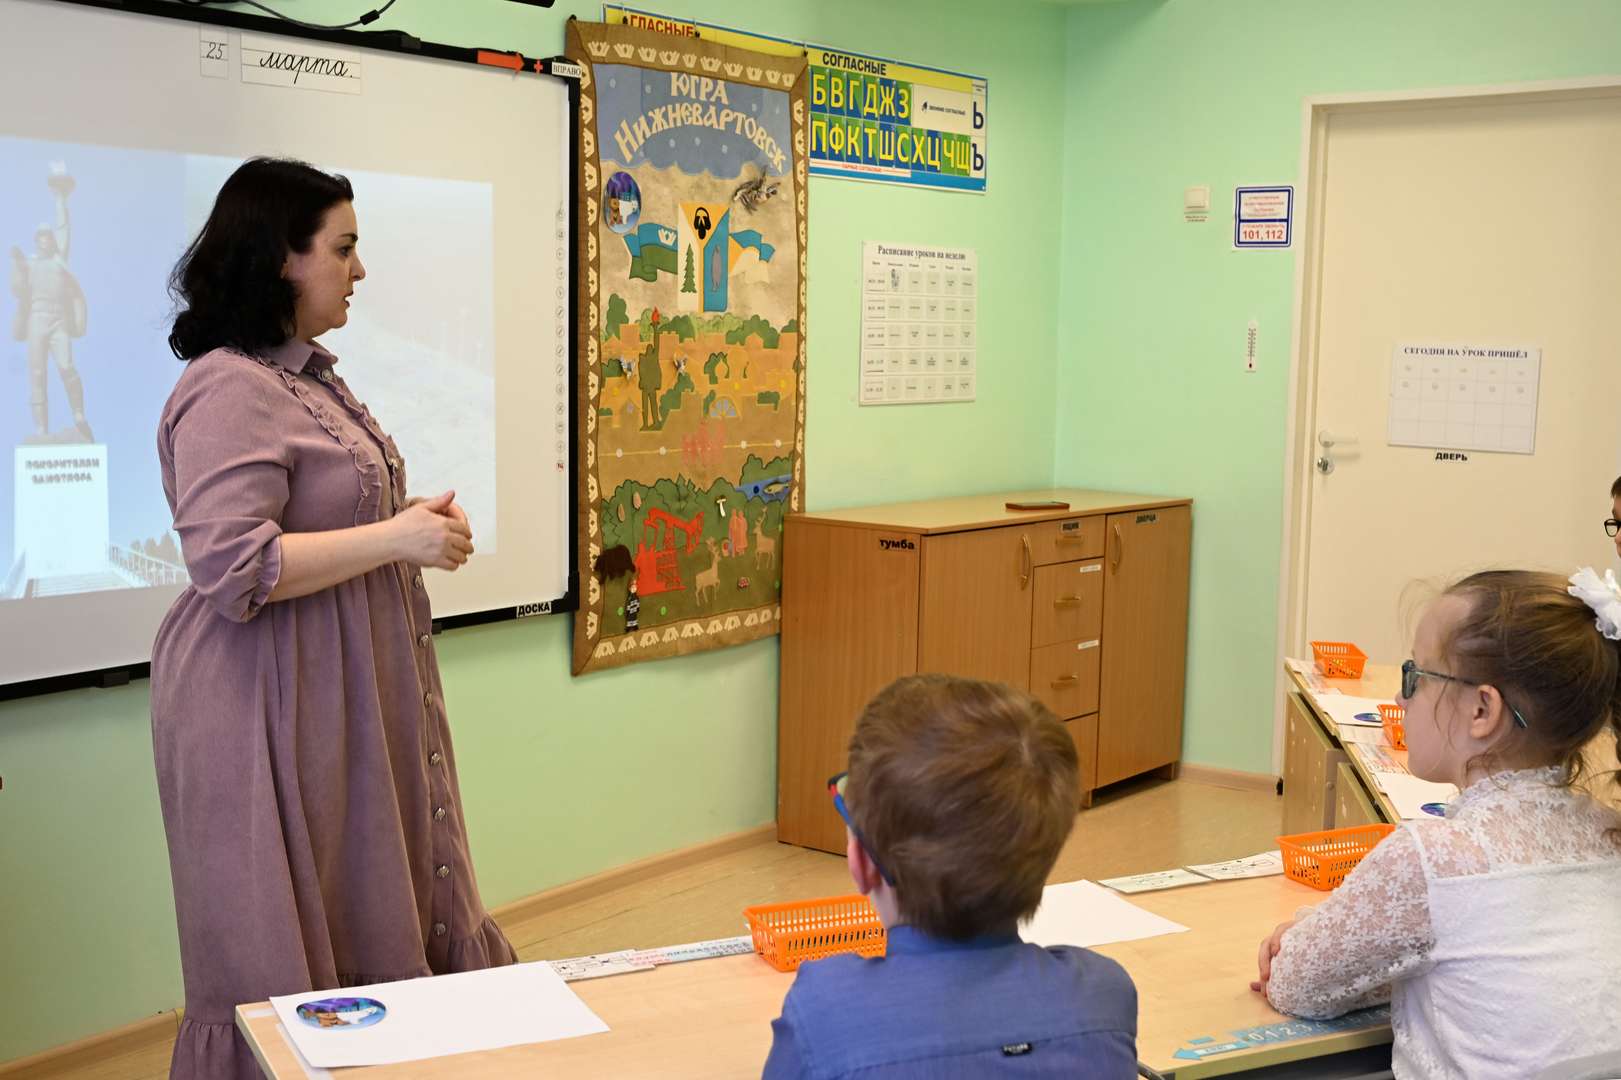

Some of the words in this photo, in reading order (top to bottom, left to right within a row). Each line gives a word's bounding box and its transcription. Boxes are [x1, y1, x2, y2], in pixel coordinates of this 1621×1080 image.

[630, 15, 694, 38] ГЛАСНЫЕ
[206, 42, 227, 60] 25
[553, 64, 582, 76] ВПРАВО
[822, 52, 887, 76] СОГЛАСНЫЕ
[670, 71, 729, 105] ЮГРА
[878, 245, 914, 257] Расписание
[1404, 347, 1445, 356] СЕГОДНЯ
[1447, 348, 1460, 356] НА
[1462, 348, 1487, 357] УРОК
[1435, 452, 1468, 461] ДВЕРЬ
[880, 539, 915, 550] тумба
[518, 602, 550, 616] ДОСКА
